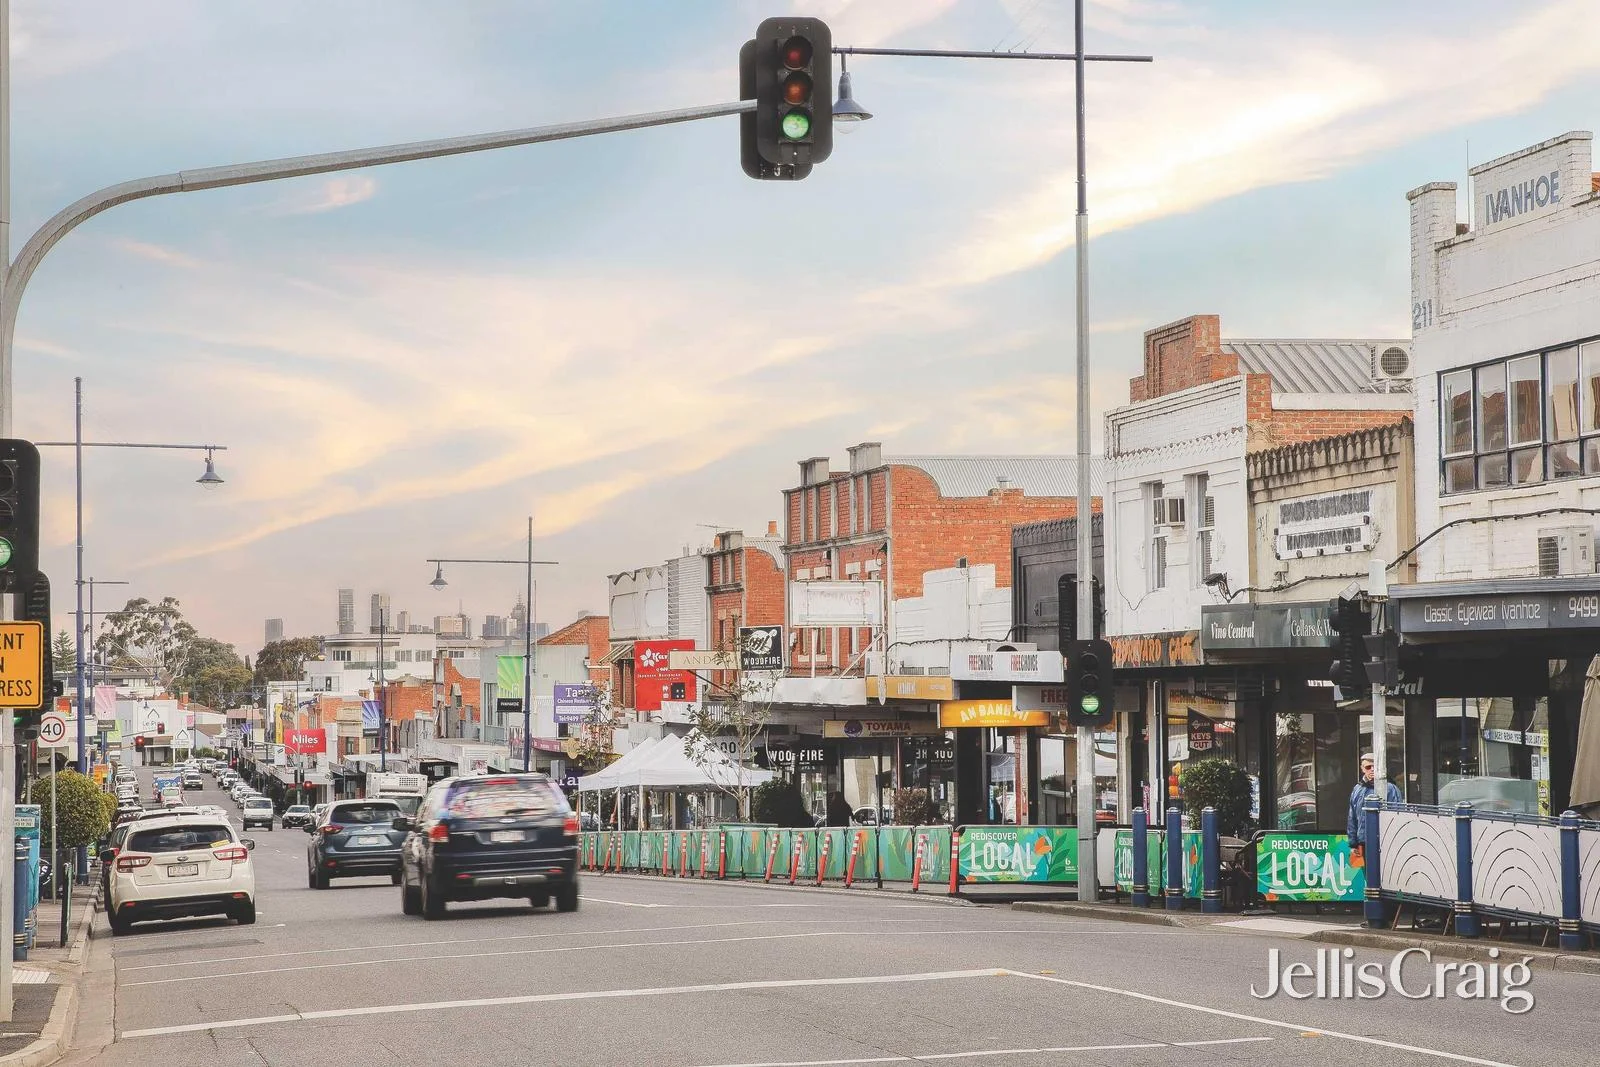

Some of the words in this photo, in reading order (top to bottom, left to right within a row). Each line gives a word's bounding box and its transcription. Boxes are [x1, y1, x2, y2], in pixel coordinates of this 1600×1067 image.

[1485, 170, 1560, 225] IVANHOE
[1412, 299, 1432, 330] 211
[1424, 603, 1453, 623] Classic
[1457, 602, 1497, 626] Eyewear
[1502, 600, 1541, 620] Ivanhoe
[1568, 596, 1599, 618] 9499
[1211, 622, 1227, 639] Vino
[1228, 621, 1255, 639] Central
[1290, 620, 1316, 637] Cellars
[1316, 619, 1323, 637] &
[41, 723, 62, 736] 40
[866, 721, 911, 731] TOYAMA
[1191, 732, 1211, 740] KEYS
[1193, 741, 1209, 749] CUT
[970, 832, 1018, 841] REDISCOVER
[1271, 839, 1329, 850] REDISCOVER
